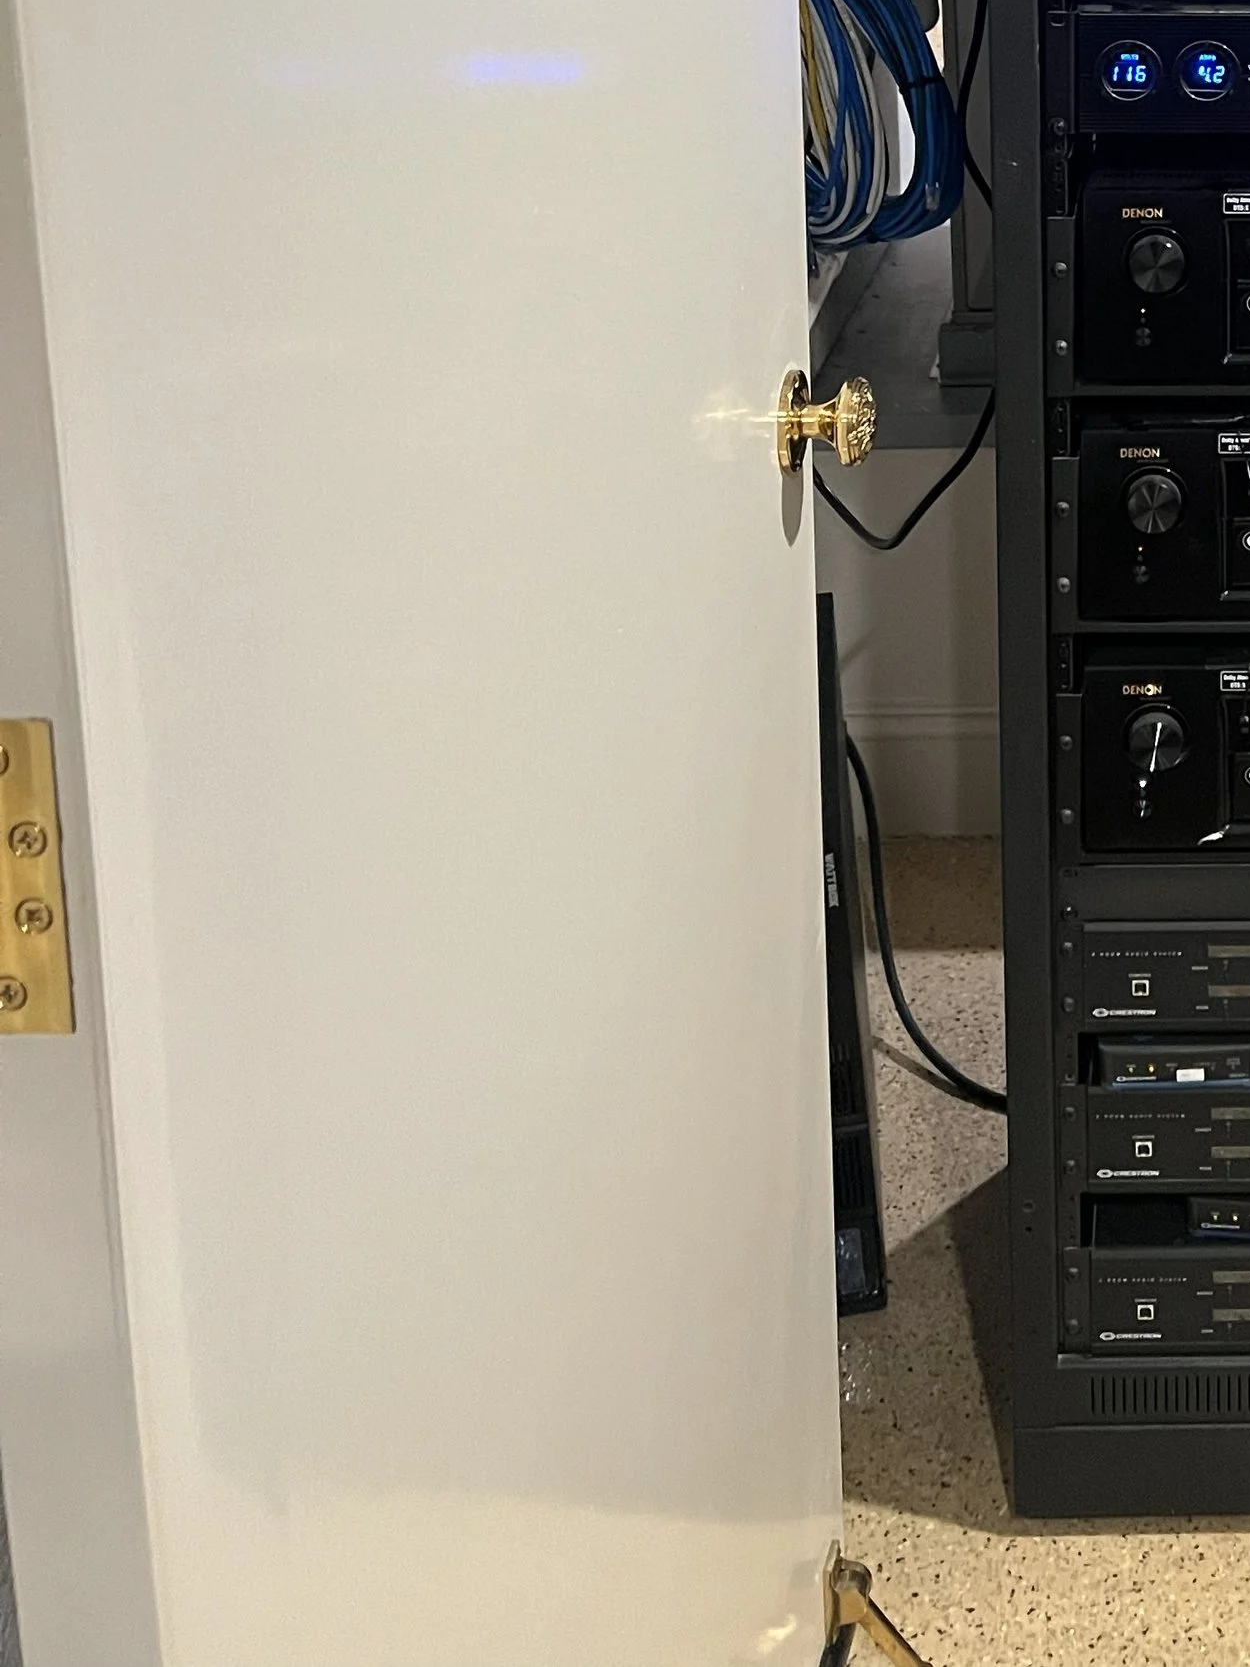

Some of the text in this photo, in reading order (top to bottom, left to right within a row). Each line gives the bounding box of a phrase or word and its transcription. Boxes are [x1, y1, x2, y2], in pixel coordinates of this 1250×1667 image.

[1112, 65, 1147, 83] 116
[1122, 207, 1164, 218] DENON
[1119, 447, 1161, 458] DENON
[1122, 684, 1163, 695] DENON
